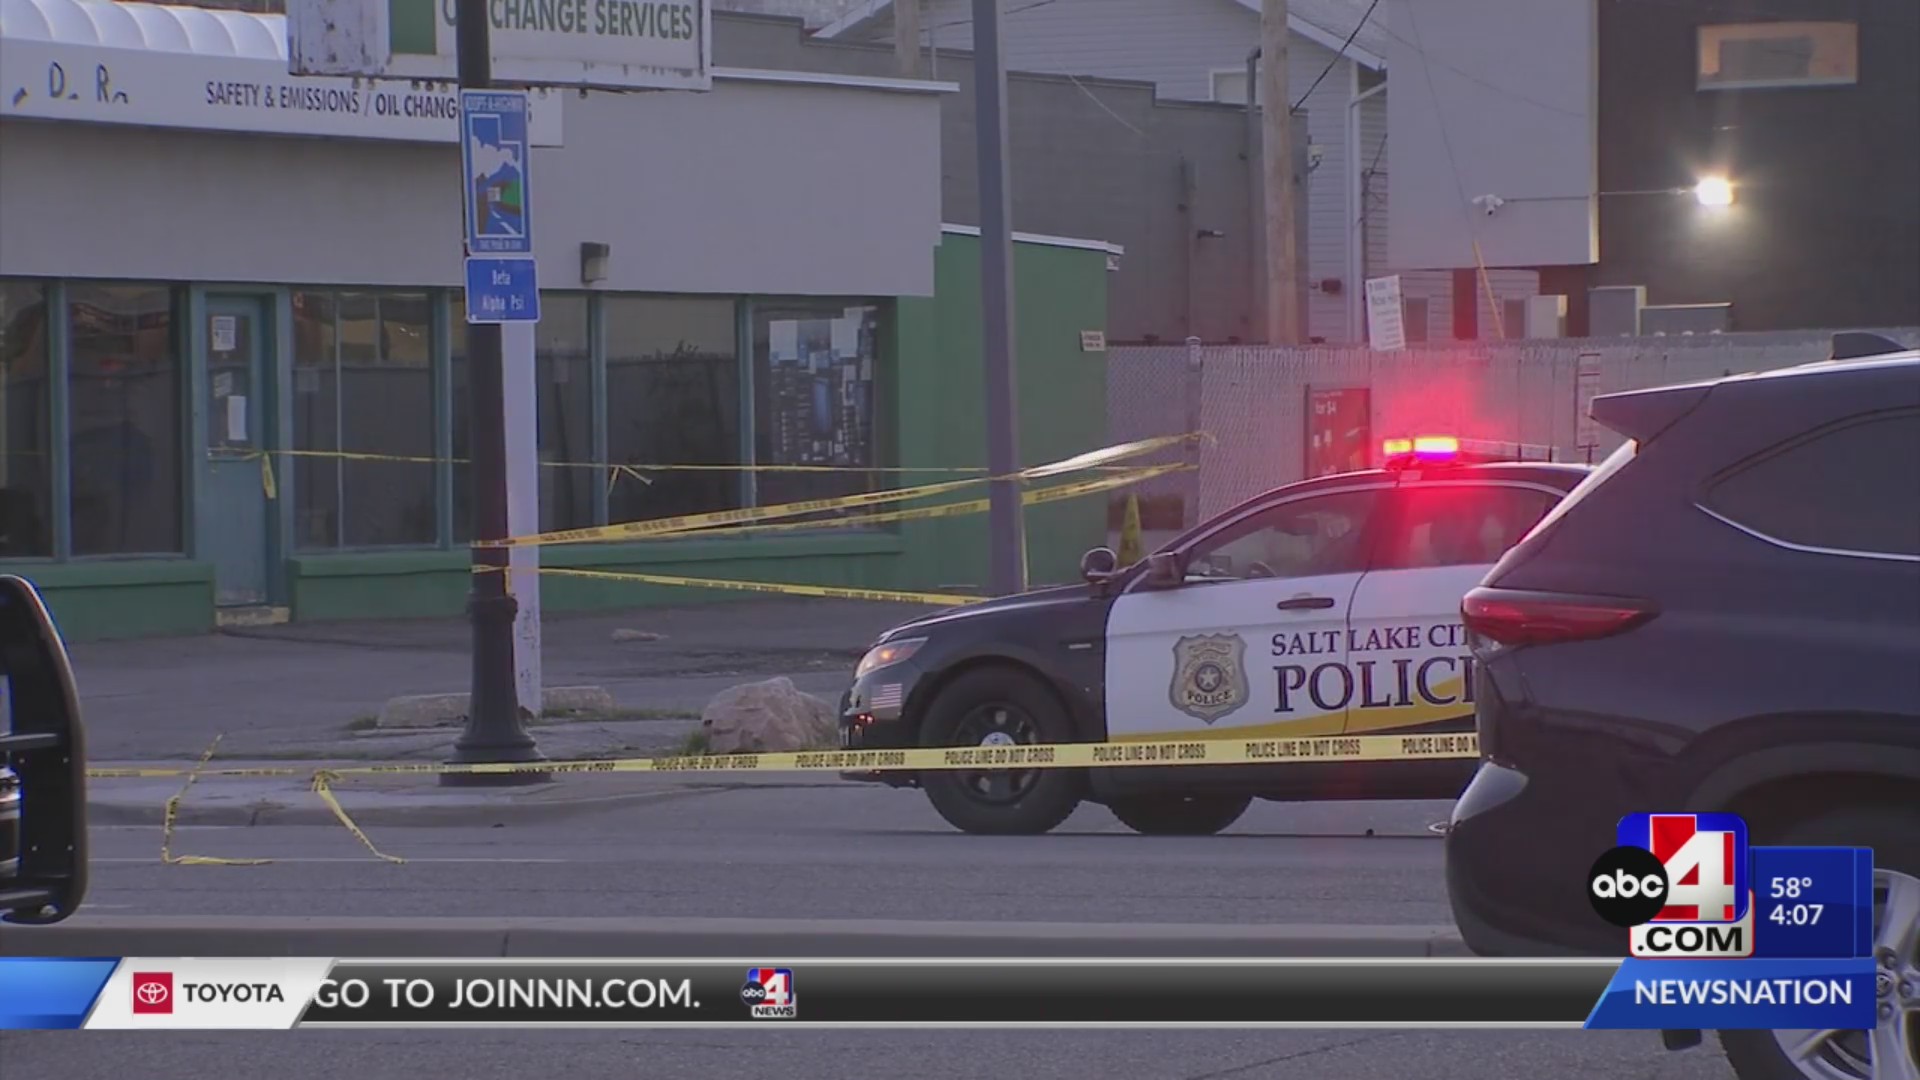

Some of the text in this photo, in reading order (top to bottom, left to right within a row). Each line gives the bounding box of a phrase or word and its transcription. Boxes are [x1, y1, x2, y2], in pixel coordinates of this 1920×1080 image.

[489, 0, 588, 34] CHANGE
[595, 0, 693, 40] SERVICES
[205, 80, 260, 108] SAFETY
[264, 85, 275, 109] &
[279, 86, 361, 115] EMISSIONS
[376, 93, 400, 117] OIL
[403, 97, 458, 121] CHANG
[492, 268, 512, 287] Beta
[482, 293, 526, 313] Alpha Psi
[1271, 629, 1341, 656] SALT
[1349, 626, 1421, 651] LAKE
[1186, 689, 1233, 705] POLICE
[1093, 743, 1206, 761] POLICE LINE DO NOT CROSS
[1246, 739, 1360, 758] POLICE LINE DO NOT CROSS
[1402, 737, 1432, 754] POLICE
[1434, 736, 1454, 753] LINE
[1456, 736, 1469, 752] DO
[795, 751, 905, 767] POLICE LINE DO NOT CROSS
[945, 747, 1055, 764] POLICE LINE DO NOT CROSS
